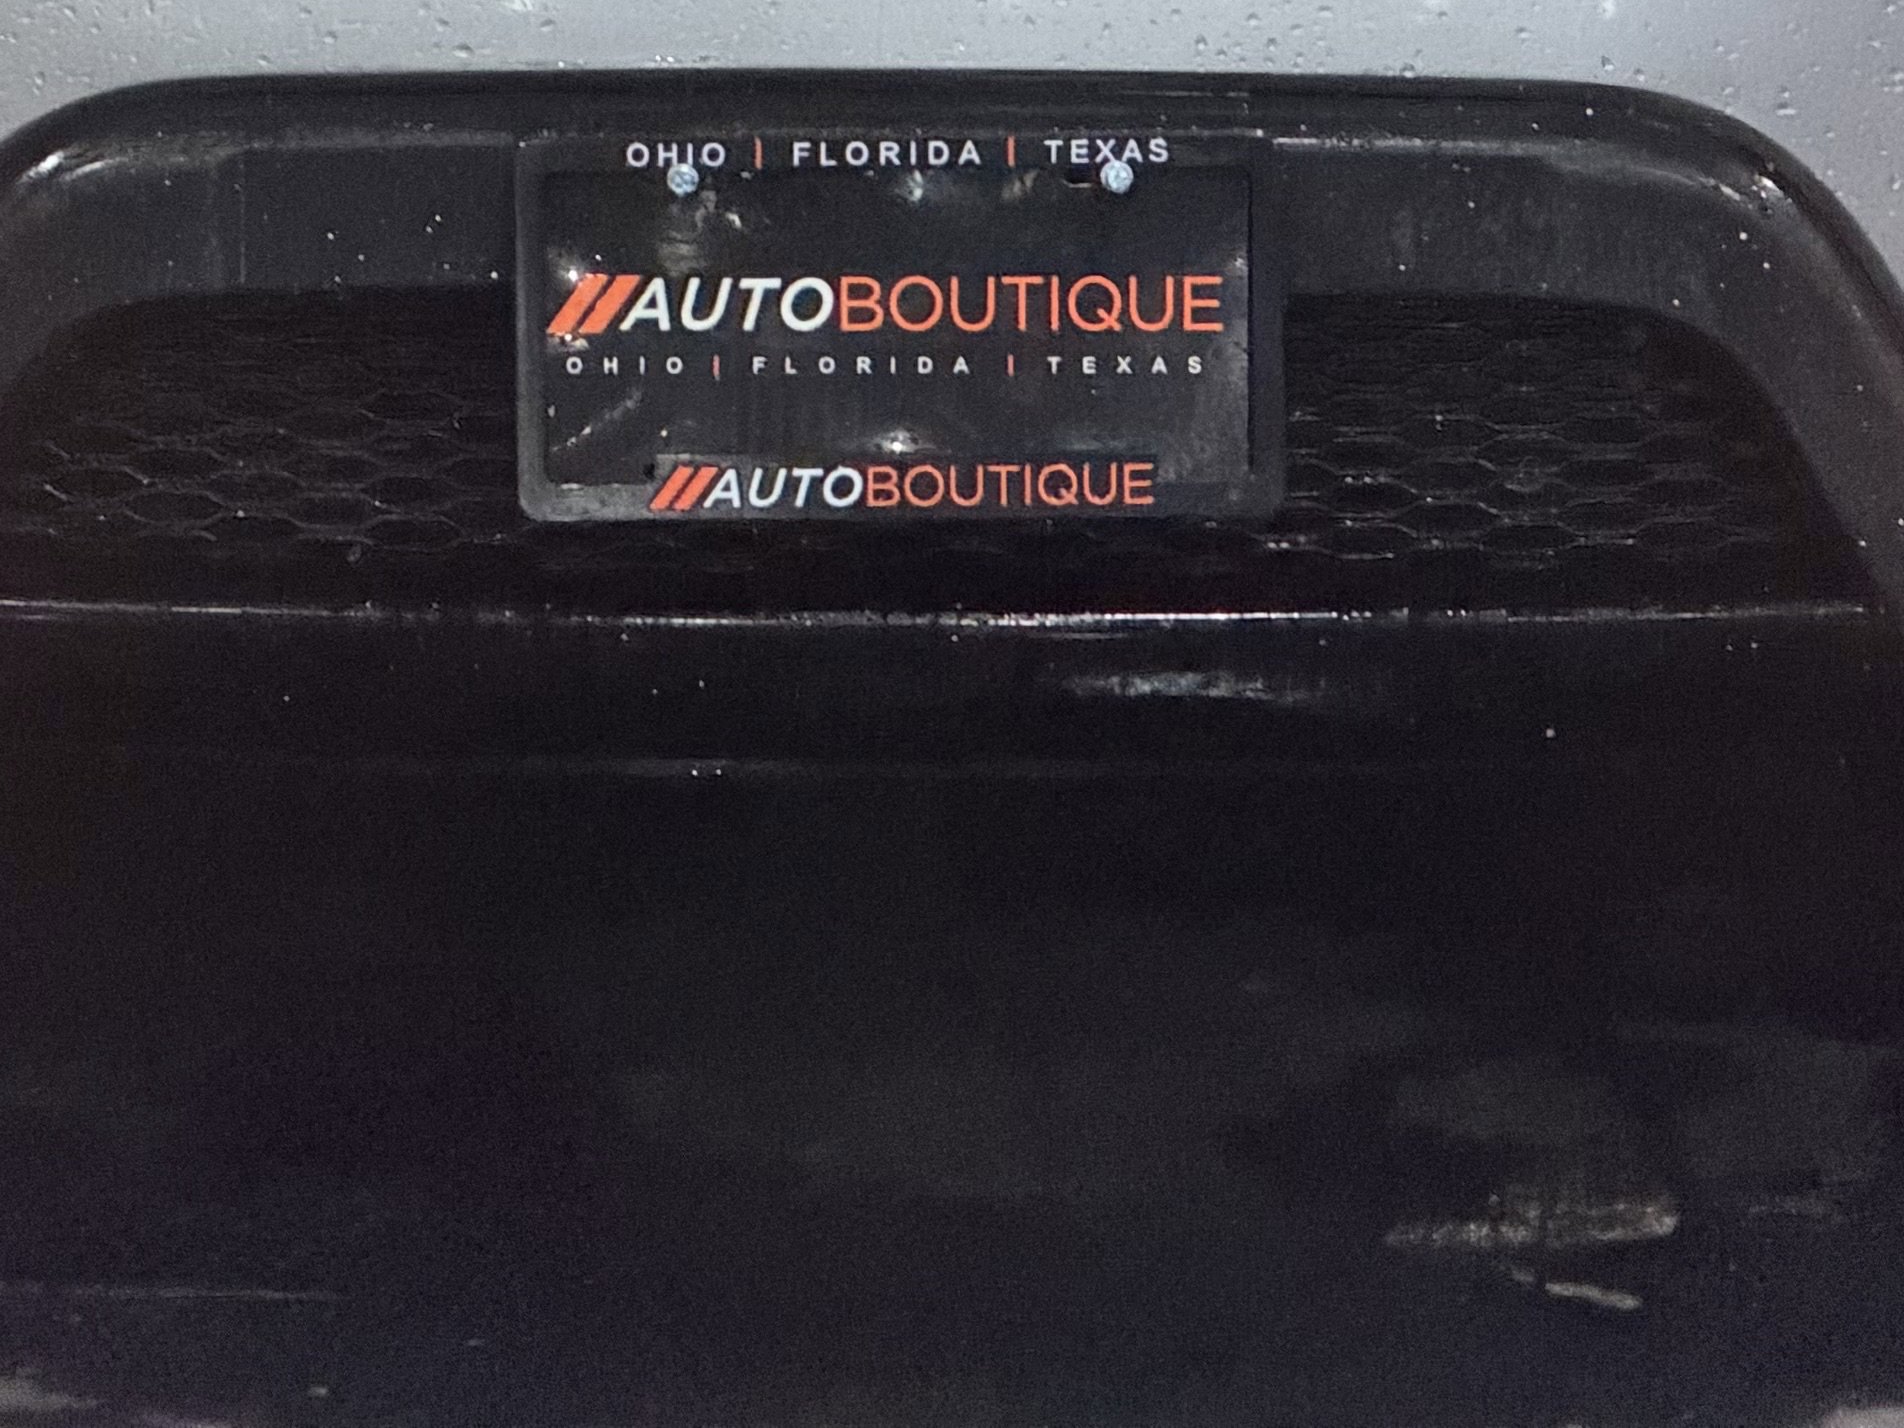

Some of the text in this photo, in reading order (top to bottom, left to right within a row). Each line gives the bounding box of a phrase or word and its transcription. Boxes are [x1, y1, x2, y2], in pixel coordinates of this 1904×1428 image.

[626, 137, 1170, 169] OHIO FLORIDA TEXAS
[619, 275, 1225, 334] AUTOBOUTIQUE
[566, 355, 1204, 376] OHIO FLORIDA TEXAS
[703, 463, 1156, 509] AUTOBOUTIQUE
